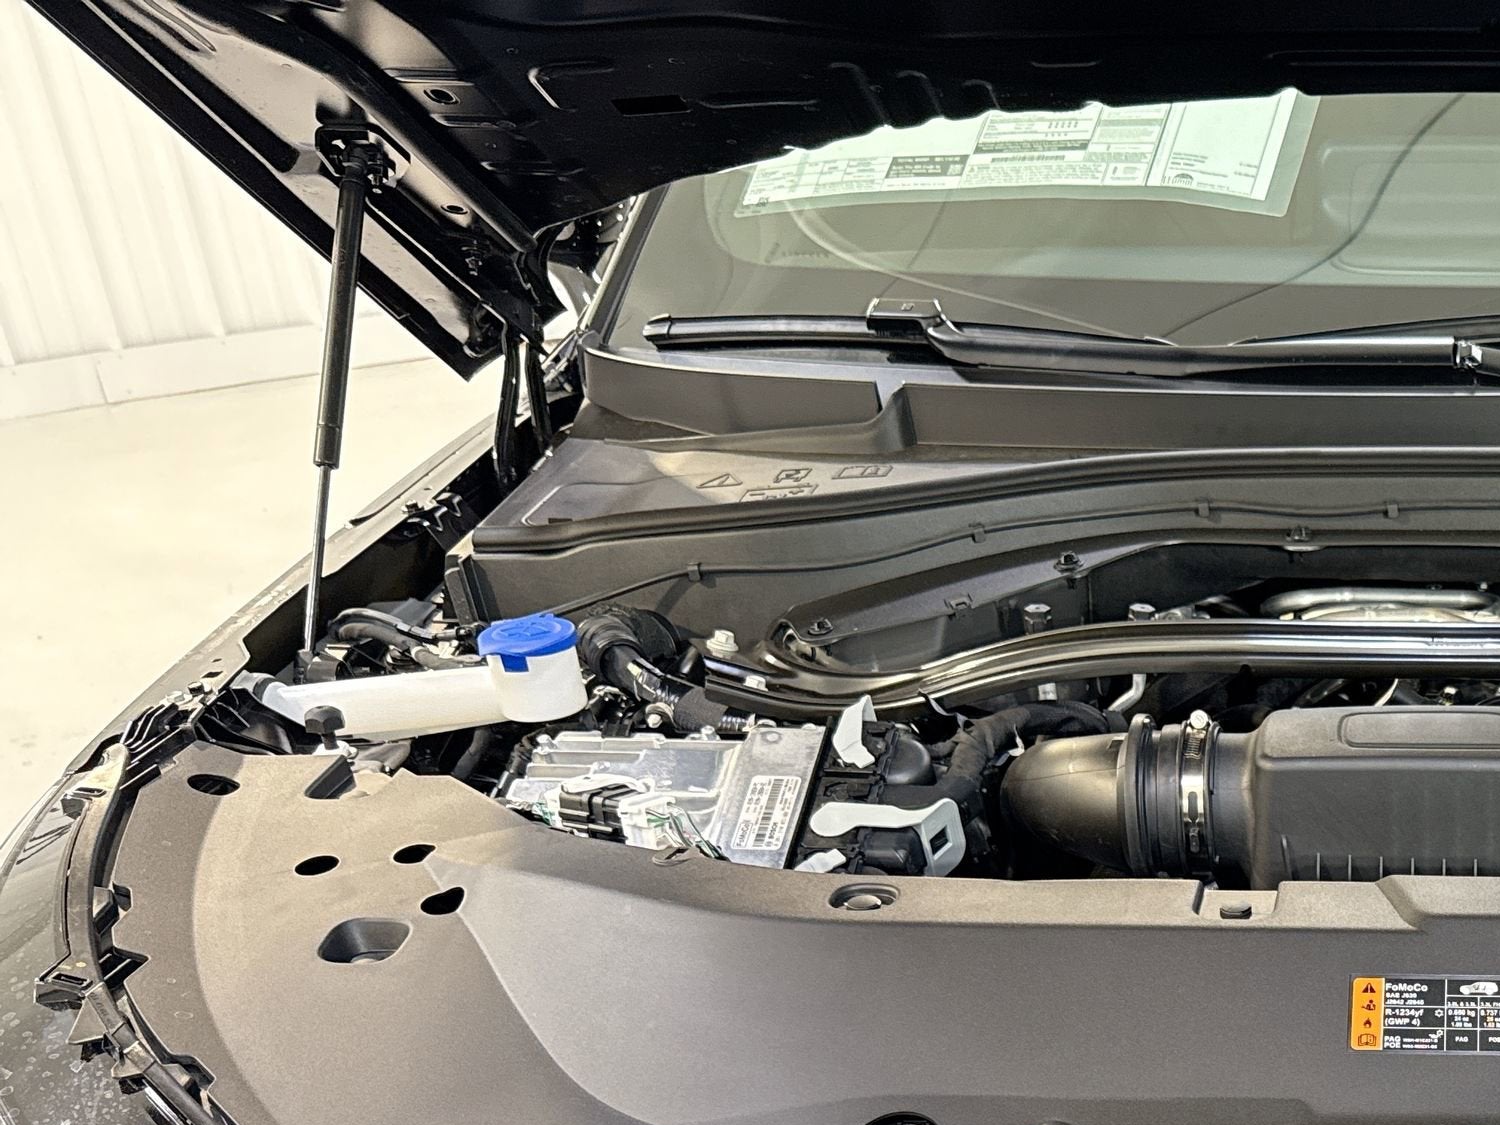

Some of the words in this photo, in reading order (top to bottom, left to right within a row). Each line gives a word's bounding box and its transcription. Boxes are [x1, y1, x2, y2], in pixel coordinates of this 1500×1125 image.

[1385, 983, 1428, 992] FoMoCo
[1385, 1009, 1424, 1017] R-1234yf
[1467, 1009, 1475, 1017] kg
[1385, 1018, 1410, 1026] (GWP
[1411, 1018, 1420, 1026] 4)
